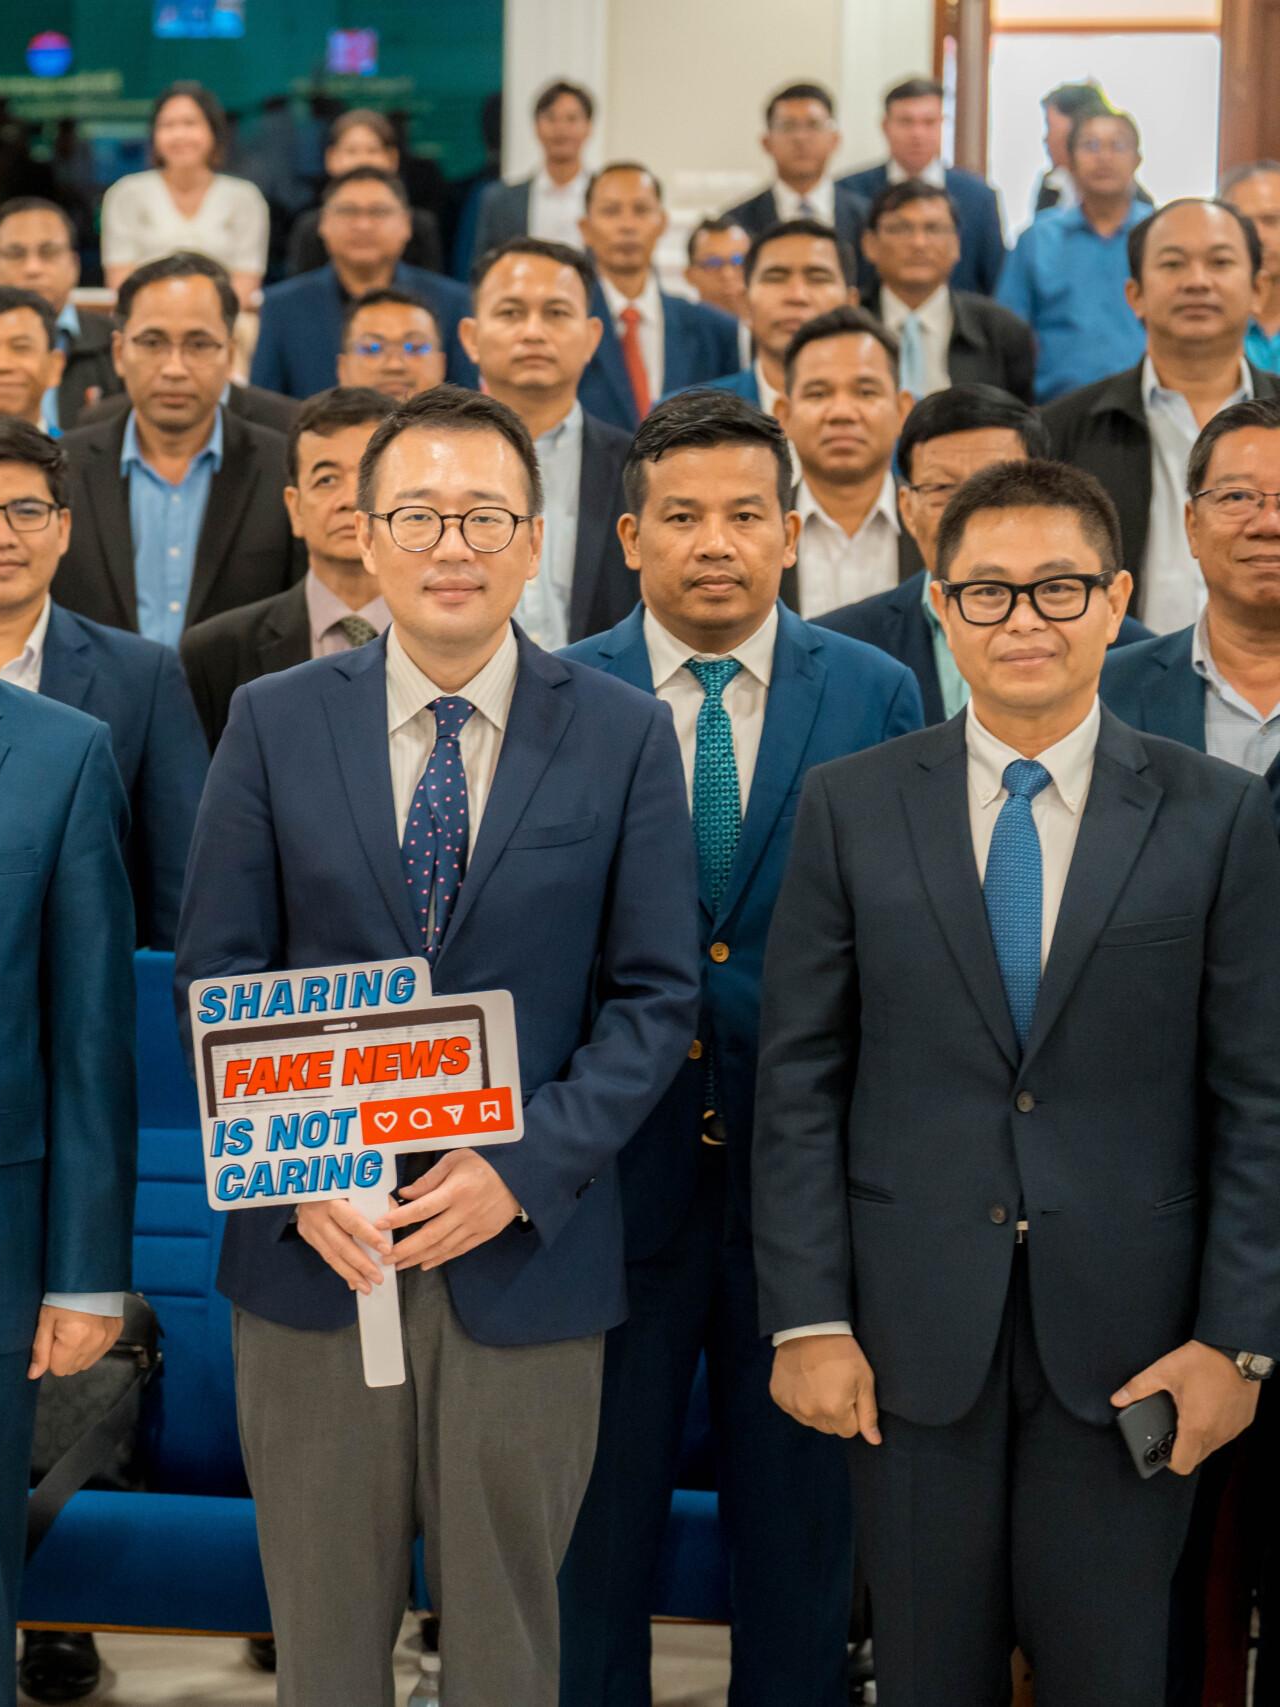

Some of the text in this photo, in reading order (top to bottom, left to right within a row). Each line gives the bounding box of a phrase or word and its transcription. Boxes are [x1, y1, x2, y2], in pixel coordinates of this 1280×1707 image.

[197, 966, 417, 1024] SHARING
[223, 1036, 472, 1099] FAKE NEWS
[209, 1107, 358, 1157] IS NOT
[215, 1150, 384, 1201] CARING
